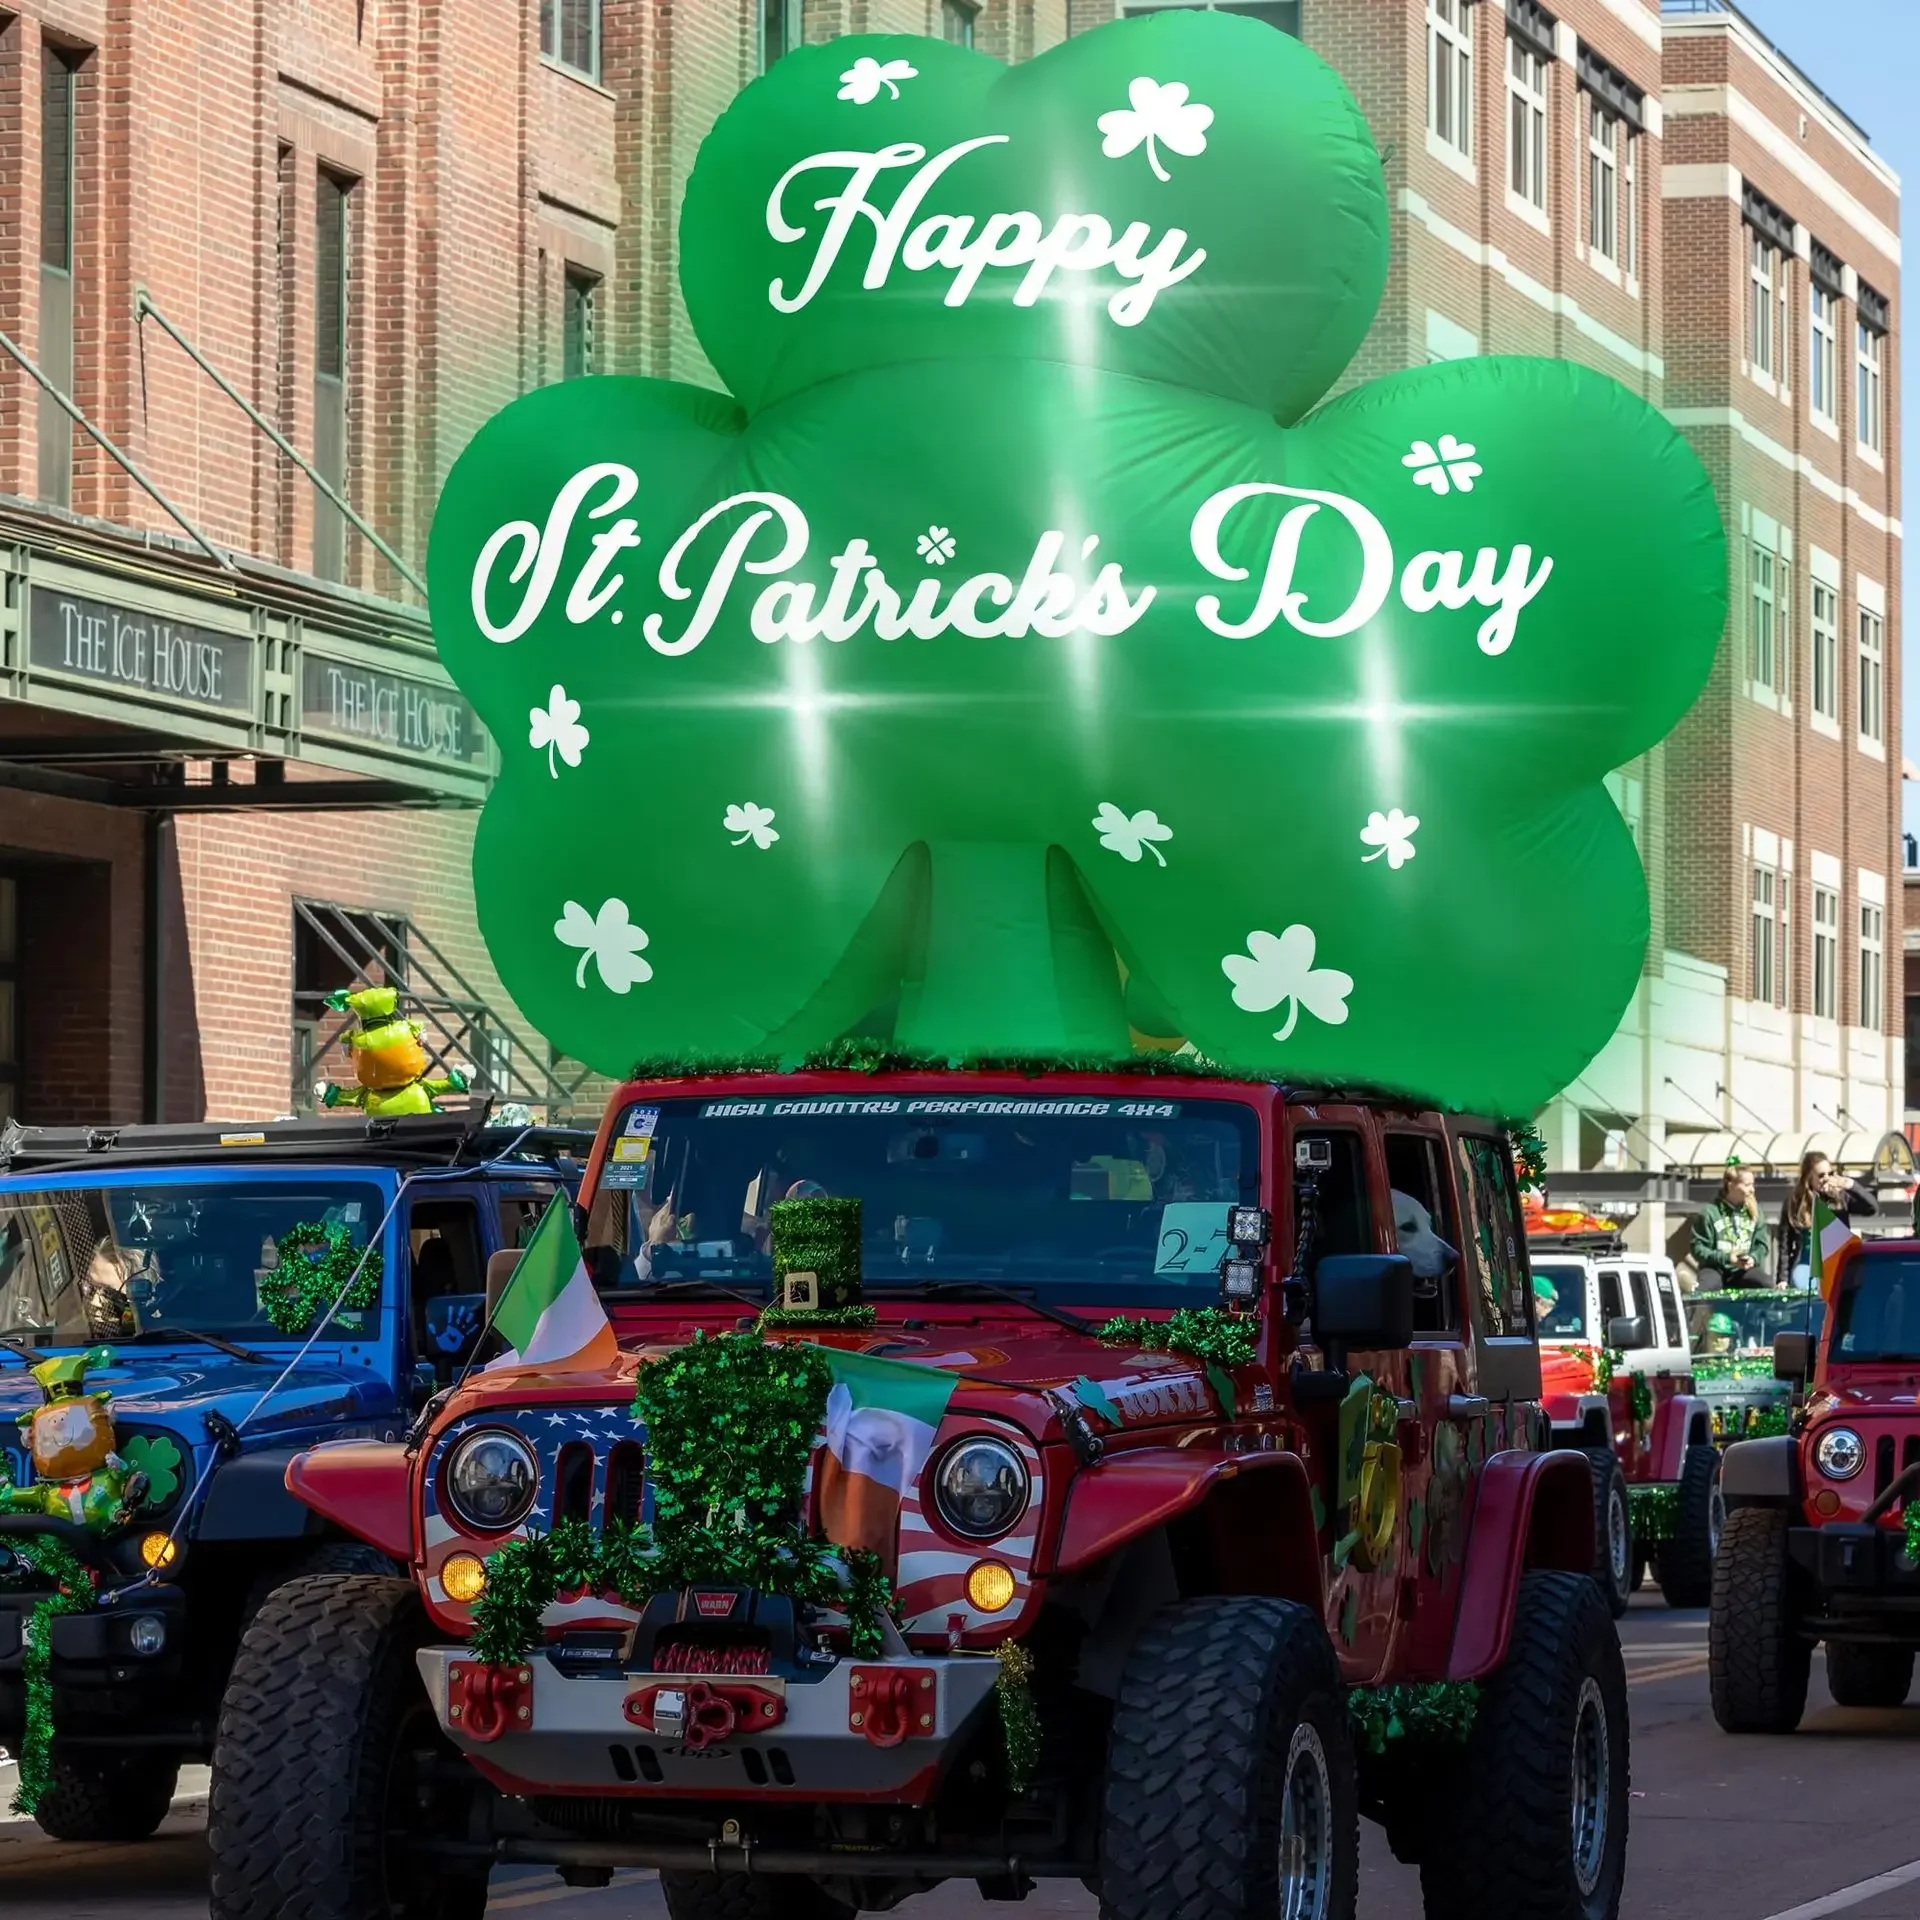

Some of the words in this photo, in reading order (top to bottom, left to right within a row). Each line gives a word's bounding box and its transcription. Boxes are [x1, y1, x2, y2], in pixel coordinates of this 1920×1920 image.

[766, 135, 1207, 326] Happy
[471, 463, 640, 643] St.
[643, 491, 1157, 657] Patrick's
[1190, 483, 1553, 656] Day
[59, 602, 107, 674] THE
[111, 614, 146, 683] ICE
[152, 624, 223, 700] HOUSE
[328, 668, 366, 732] THE
[370, 678, 399, 741] ICE
[403, 686, 462, 755] HOUSE
[705, 1103, 766, 1117] HIGH
[773, 1102, 900, 1115] COUNTRY
[906, 1102, 1110, 1115] PERFORMANCE
[700, 1600, 730, 1610] WARN
